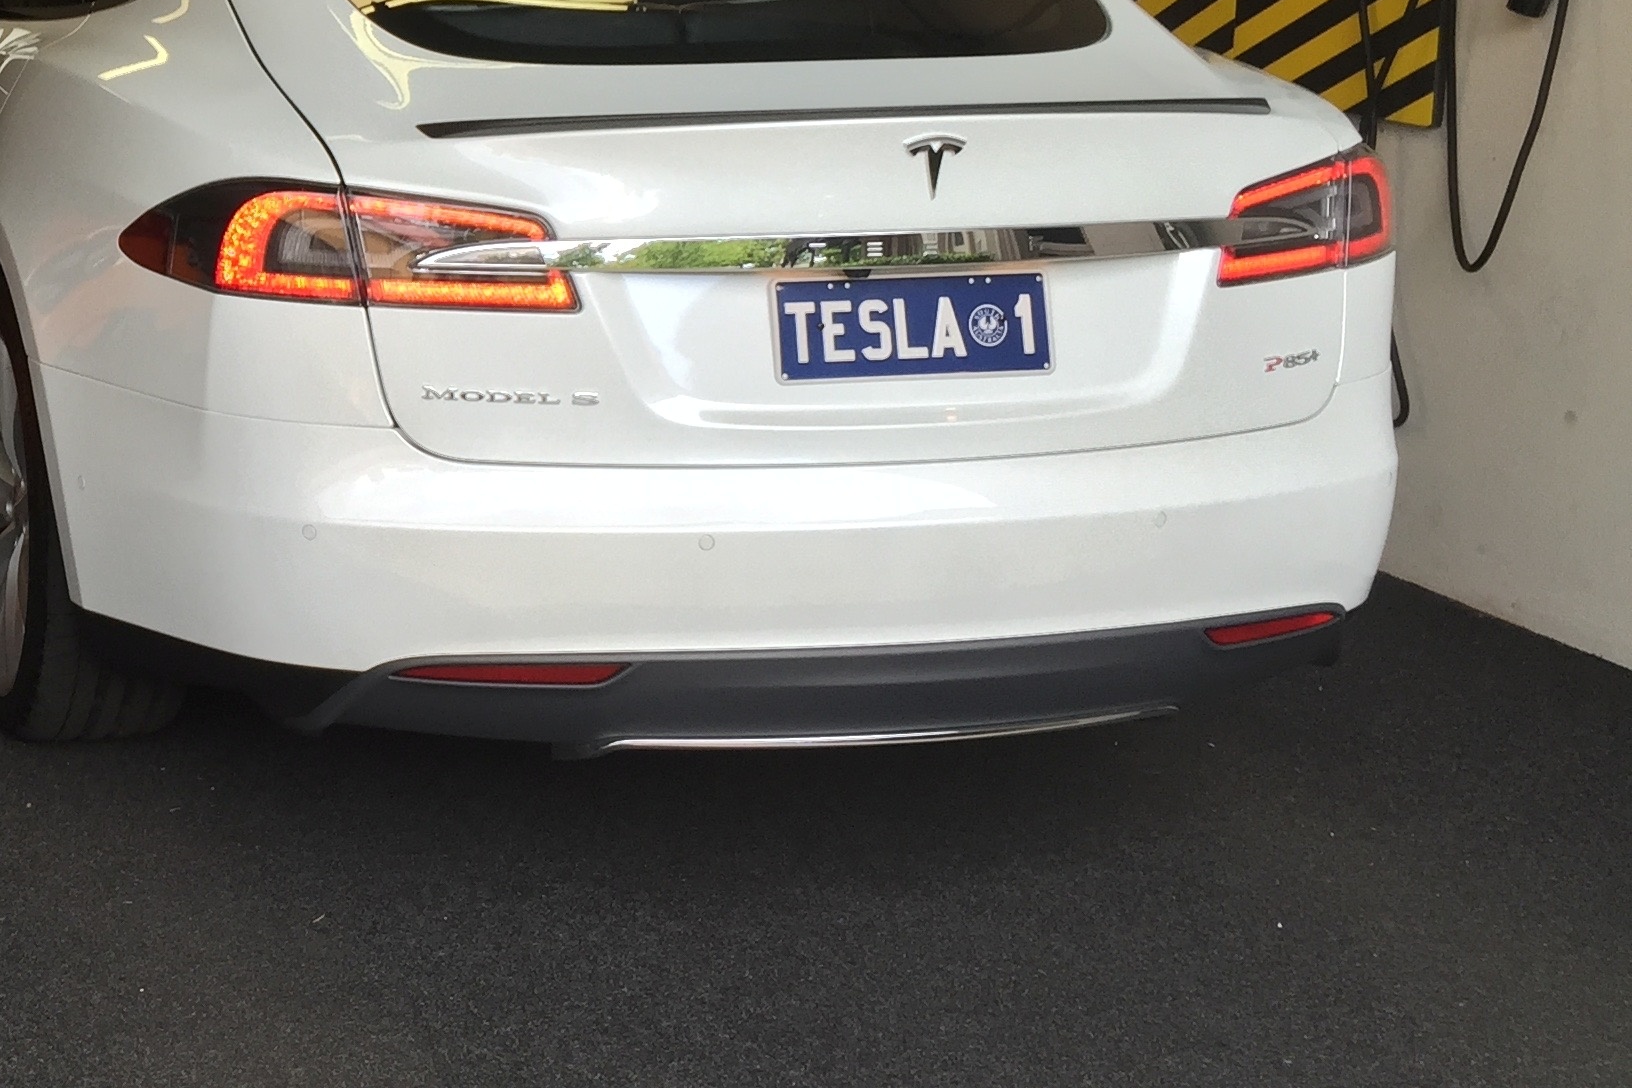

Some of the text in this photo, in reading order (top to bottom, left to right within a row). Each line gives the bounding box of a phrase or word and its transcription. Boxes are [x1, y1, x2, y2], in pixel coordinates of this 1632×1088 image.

[783, 293, 1036, 364] TESLA 1
[1263, 349, 1321, 373] P85+
[420, 384, 600, 407] MODEL S
